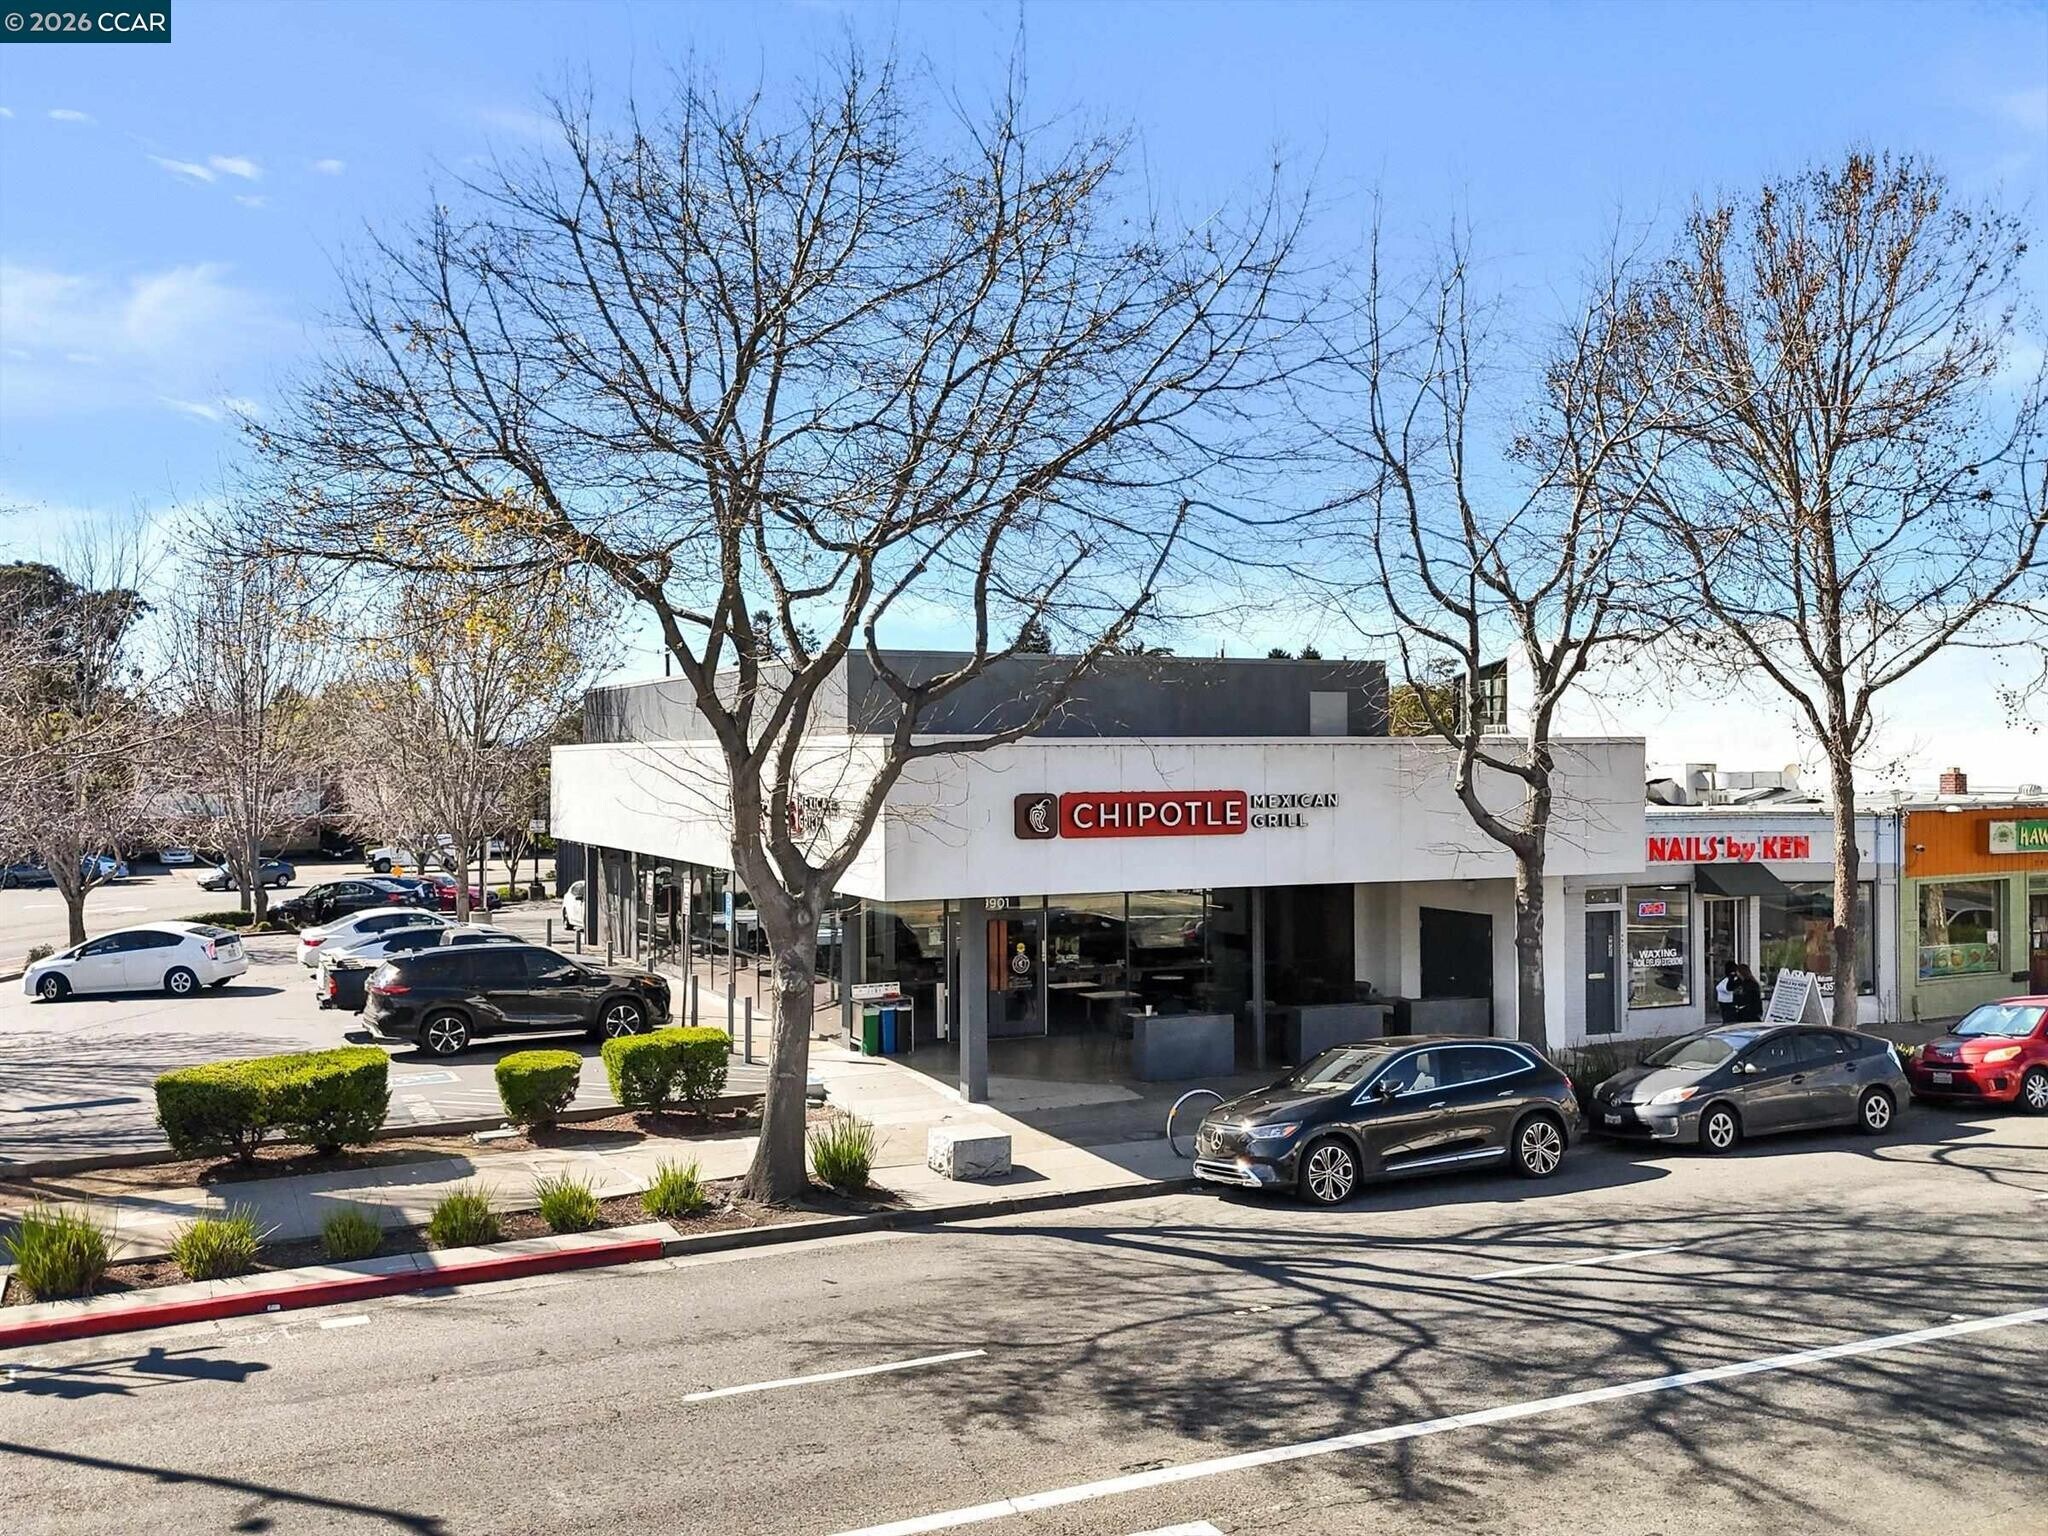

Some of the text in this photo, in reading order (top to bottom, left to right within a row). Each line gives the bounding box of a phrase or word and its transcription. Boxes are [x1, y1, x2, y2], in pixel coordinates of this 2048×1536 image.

[1251, 794, 1339, 809] MEXICAN
[1072, 800, 1242, 829] CHIPOTLE
[1251, 813, 1309, 828] GRILL
[1648, 835, 1810, 862] NAILS by KEN
[1638, 948, 1677, 959] WAXING
